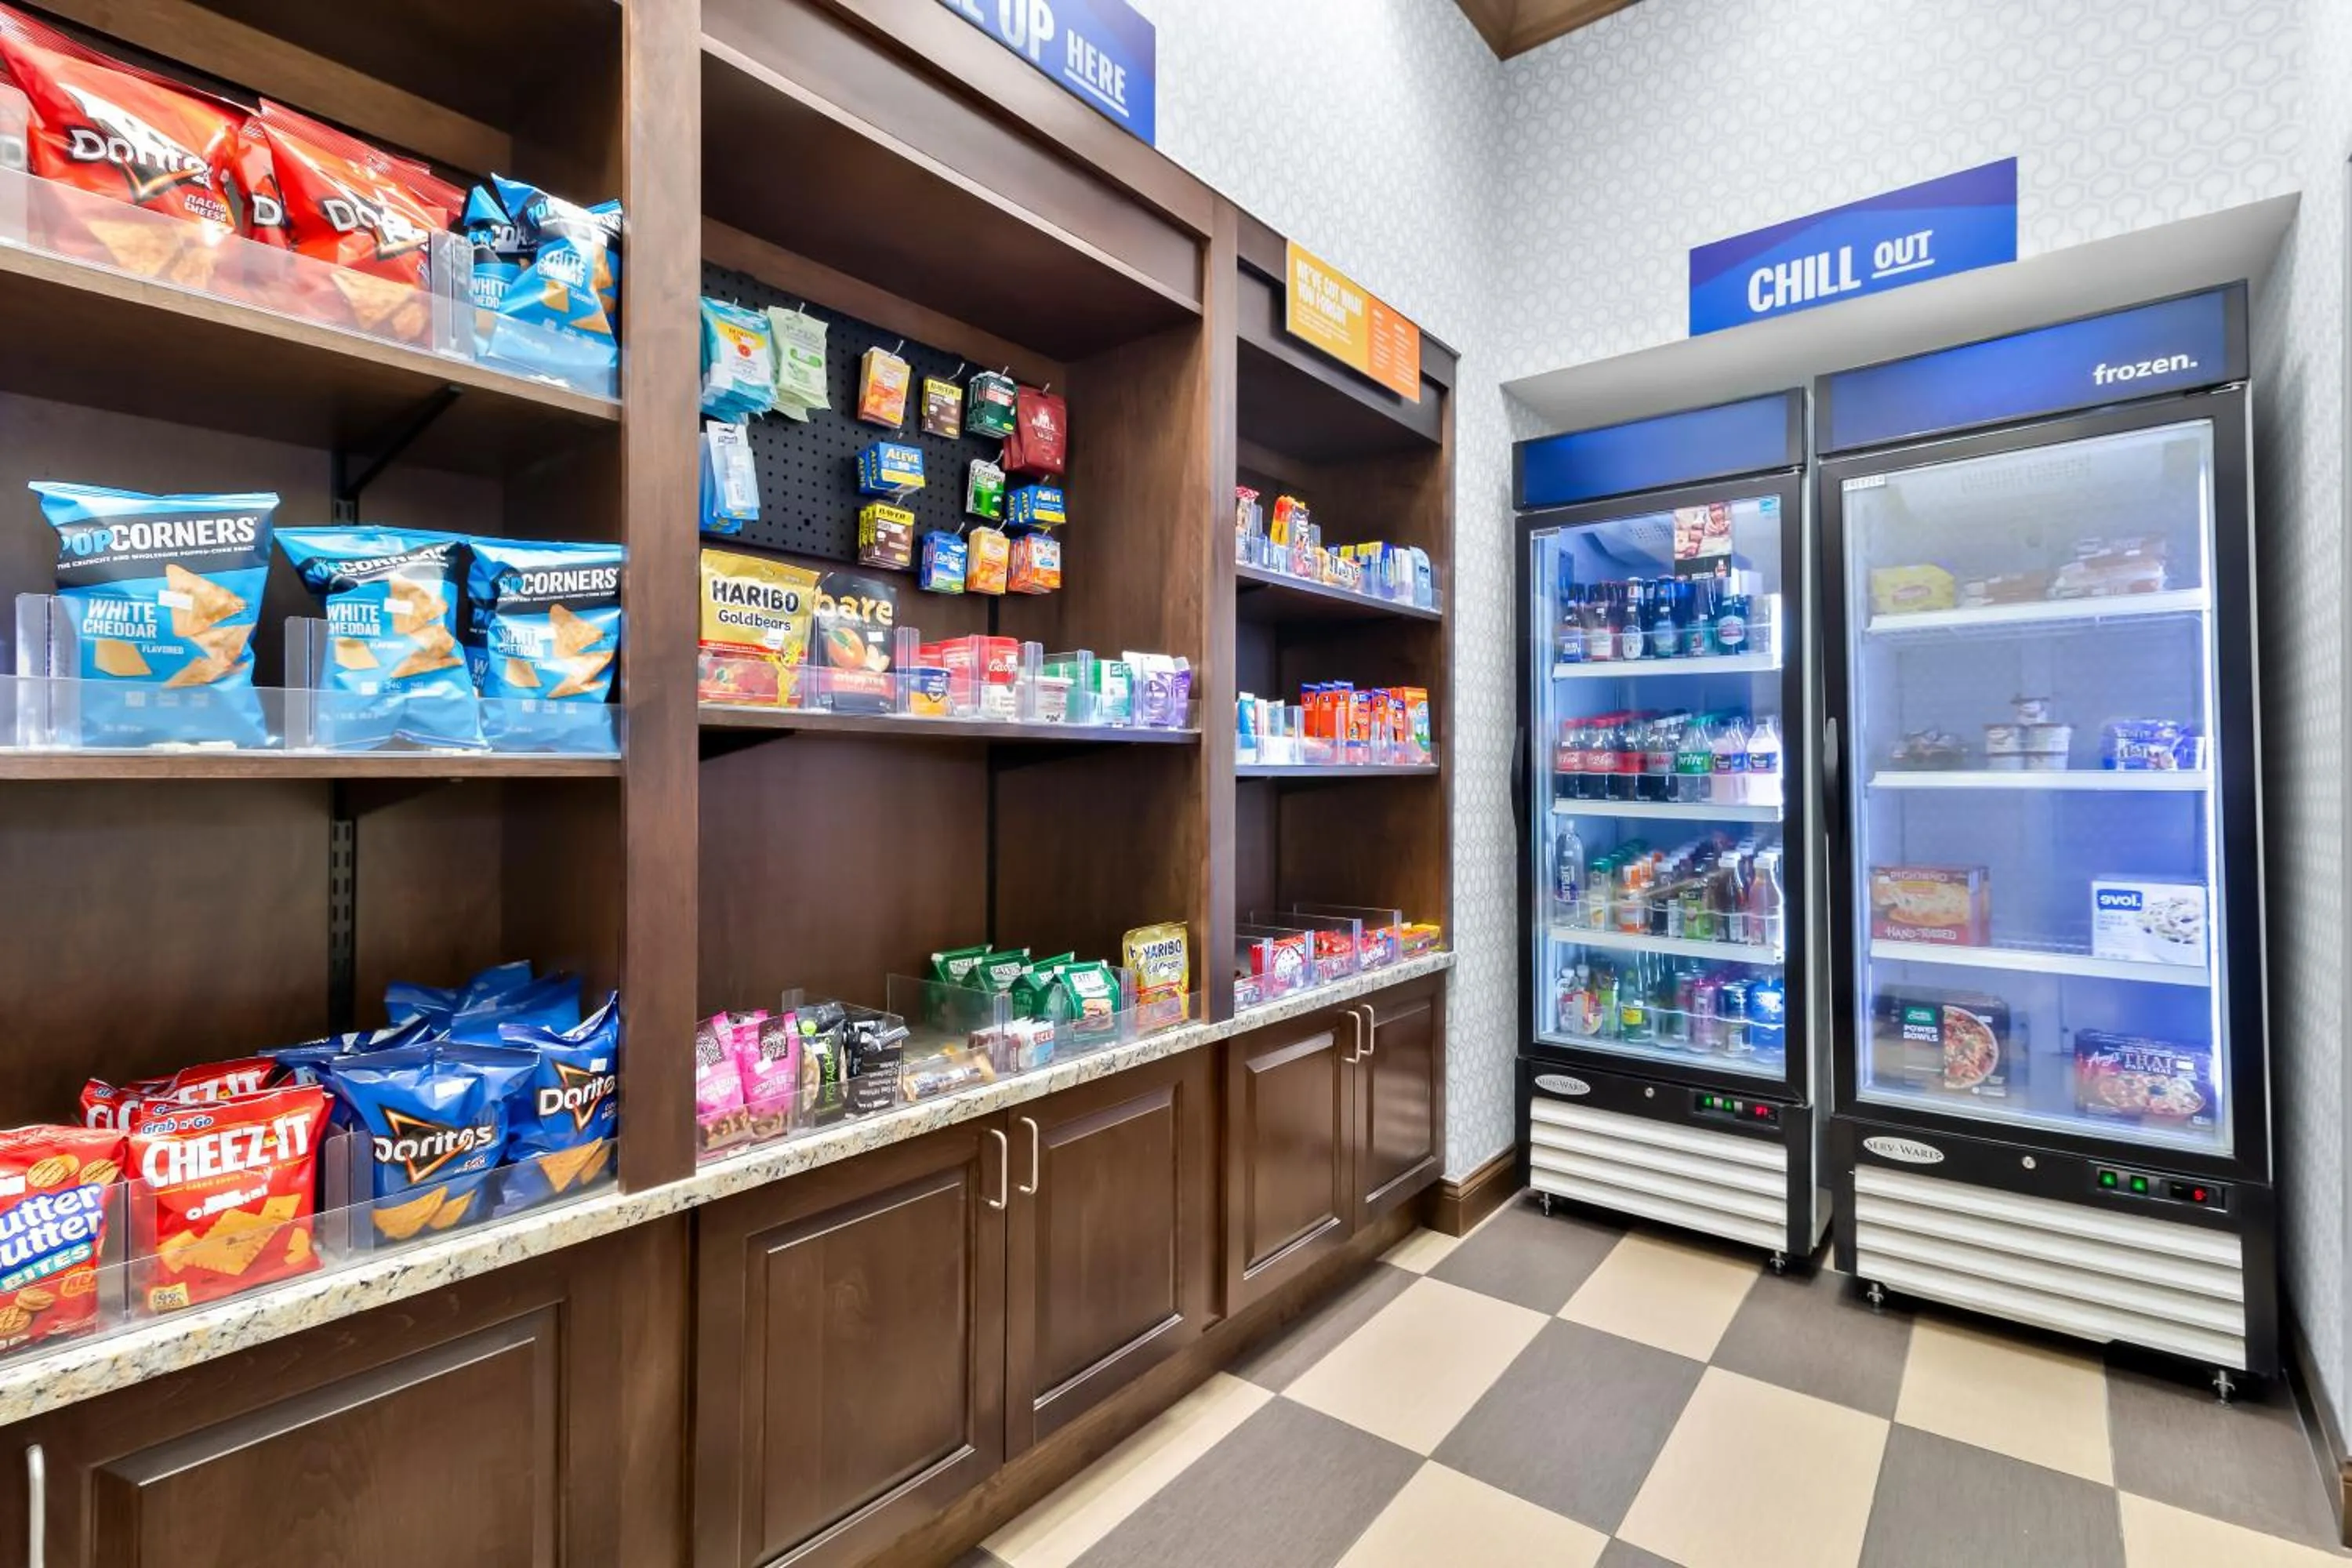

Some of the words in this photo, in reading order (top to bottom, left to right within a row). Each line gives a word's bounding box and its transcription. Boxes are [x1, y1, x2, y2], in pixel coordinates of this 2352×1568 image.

[1067, 29, 1126, 103] HERE
[184, 201, 227, 222] CHEESE
[187, 194, 227, 212] NACHO
[472, 276, 510, 297] WHIT
[1748, 246, 1861, 313] CHILL
[1875, 230, 1933, 270] OUT
[2092, 354, 2198, 385] frozen.
[886, 448, 920, 463] ALEVE
[499, 568, 619, 594] OPCORNERS
[711, 579, 800, 613] HARIBO
[88, 598, 157, 623] WHITE
[325, 603, 379, 622] WHITE
[719, 610, 791, 631] Goldbears
[814, 586, 893, 626] bare
[82, 619, 157, 639] CHEDDAR
[539, 1075, 615, 1116] Dorito
[141, 1120, 176, 1134] Grab
[194, 1115, 212, 1128] Go
[143, 1113, 312, 1187] CHEEZ-IT
[374, 1124, 492, 1163] Doritos
[0, 1185, 101, 1240] utter
[0, 1210, 103, 1267] utter
[2, 1242, 89, 1292] BITES
